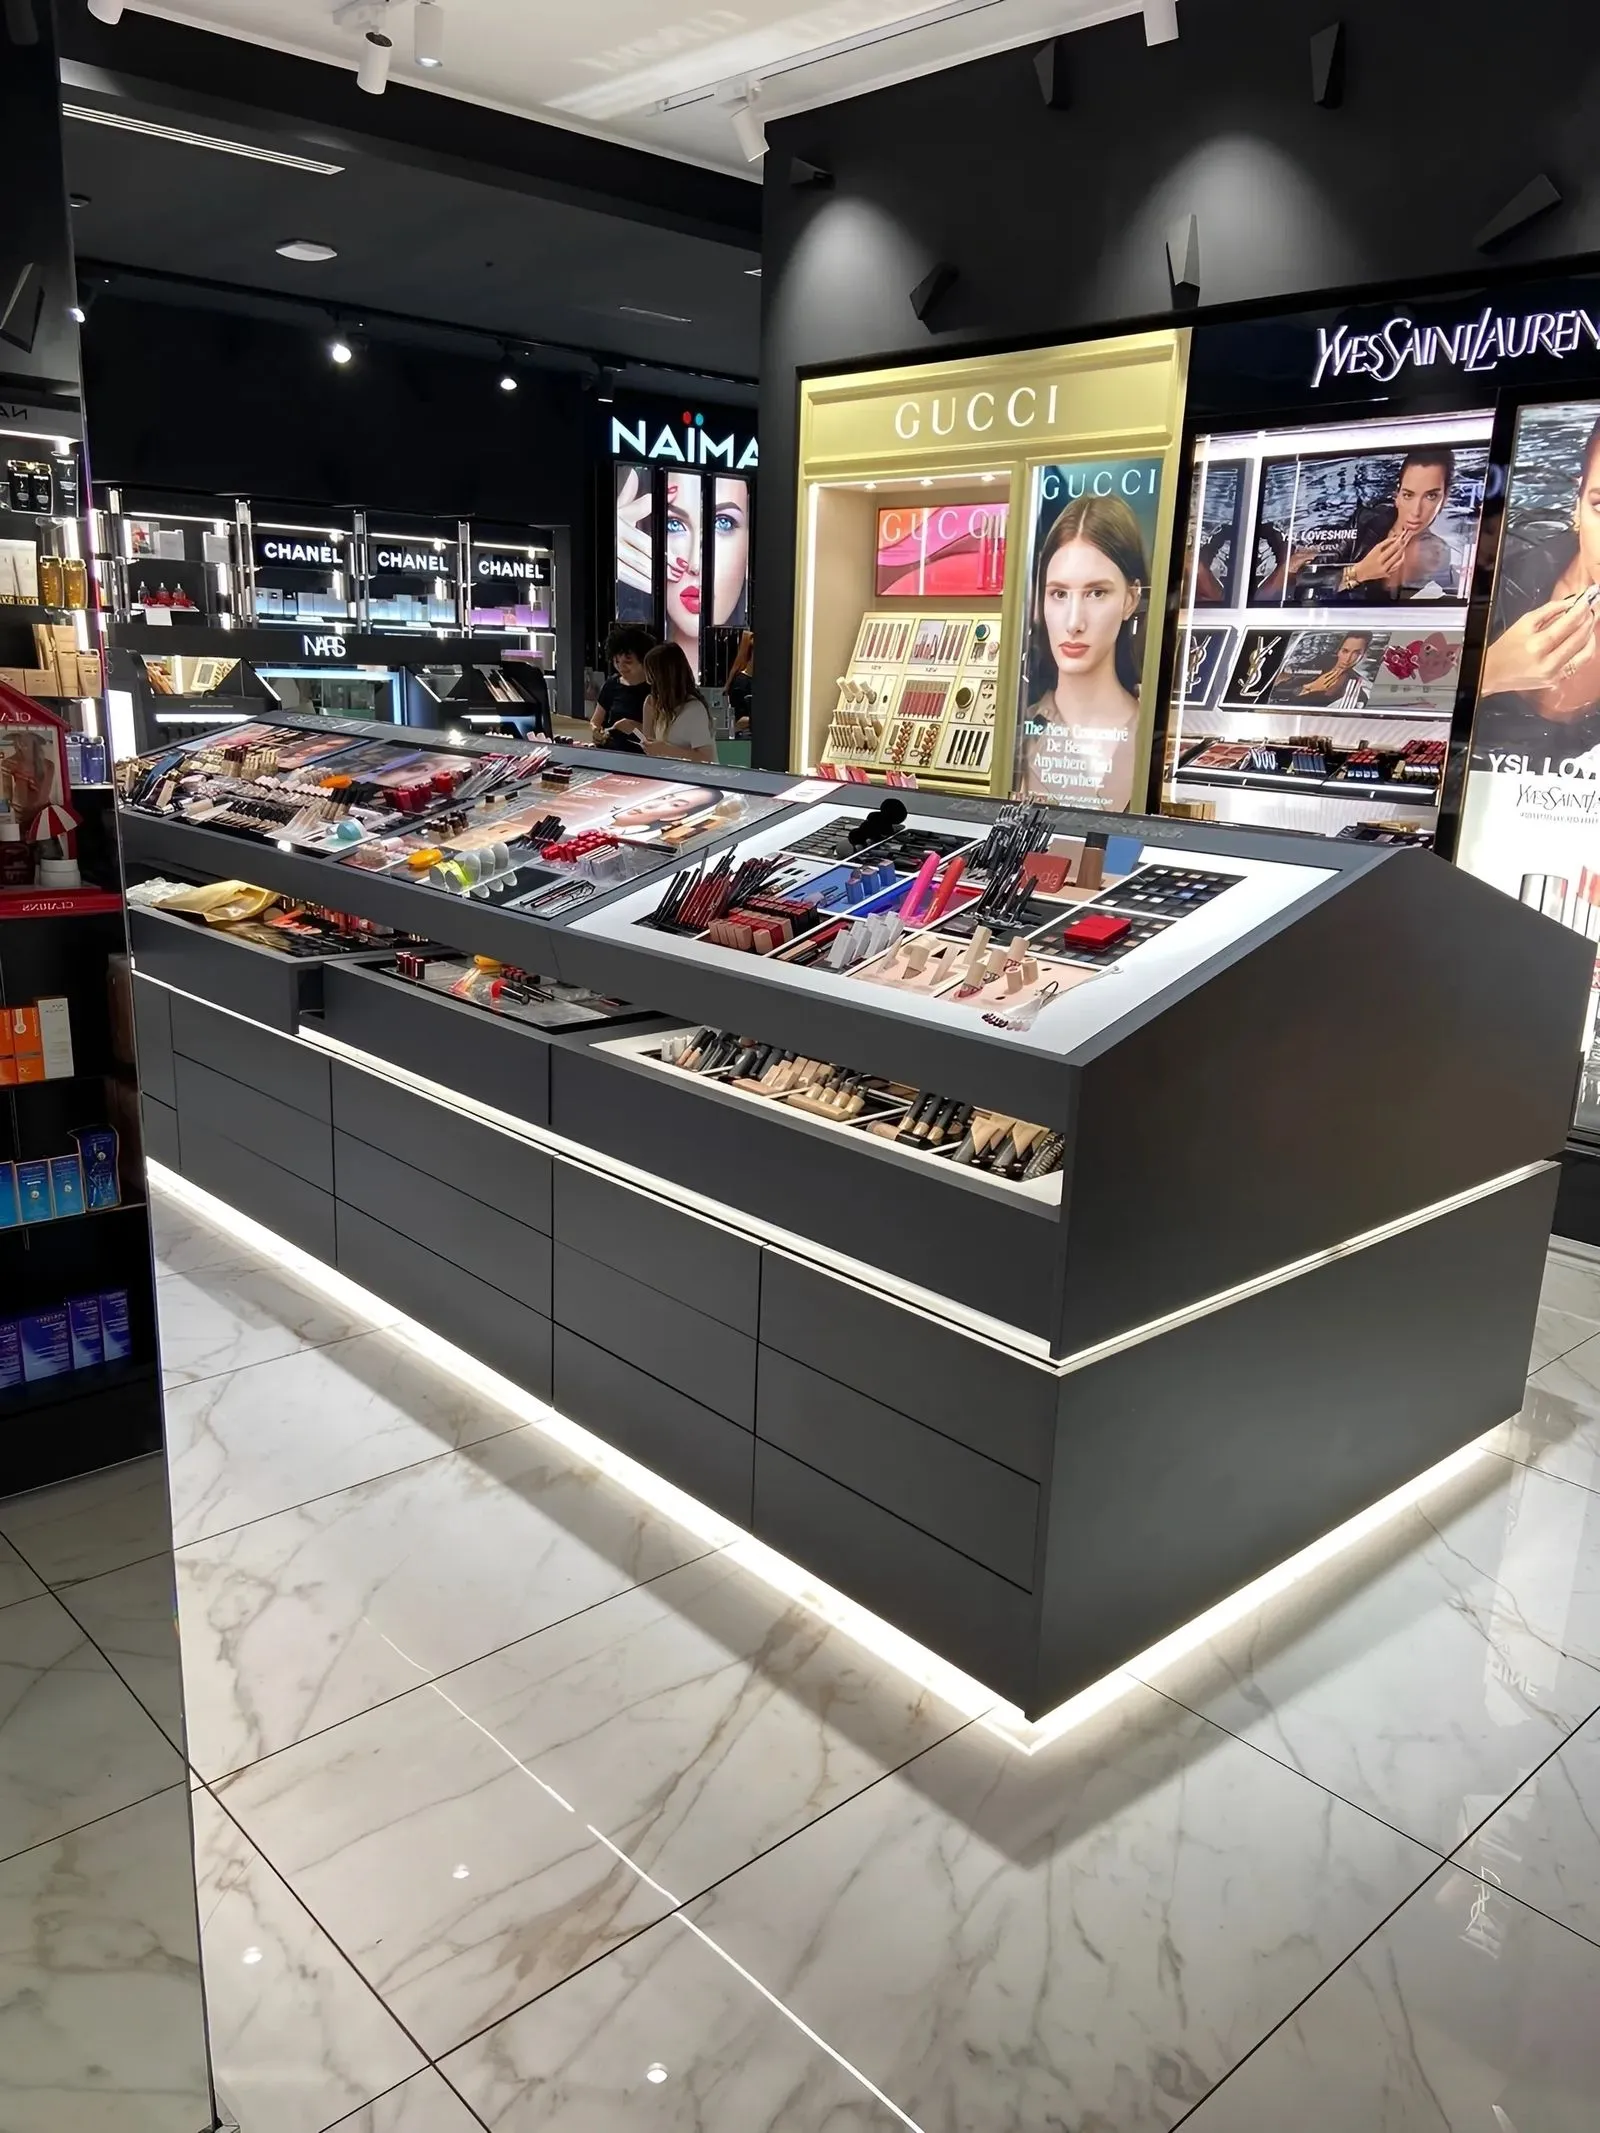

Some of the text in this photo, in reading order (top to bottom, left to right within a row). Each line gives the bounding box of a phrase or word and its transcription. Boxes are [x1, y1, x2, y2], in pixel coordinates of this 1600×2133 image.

[894, 384, 1059, 440] GUCCI
[1040, 468, 1157, 500] GUCCI
[881, 507, 1008, 543] GUCCI
[1300, 529, 1358, 542] LOVESHINE
[264, 542, 344, 564] CHANEL
[377, 551, 449, 572] CHANEL
[478, 560, 544, 579] CHANEL
[303, 634, 347, 658] NARS
[1024, 720, 1045, 736] The
[1046, 722, 1071, 738] New
[1046, 738, 1061, 752] De
[1034, 752, 1087, 772] Anywhere
[1488, 753, 1536, 776] YSL
